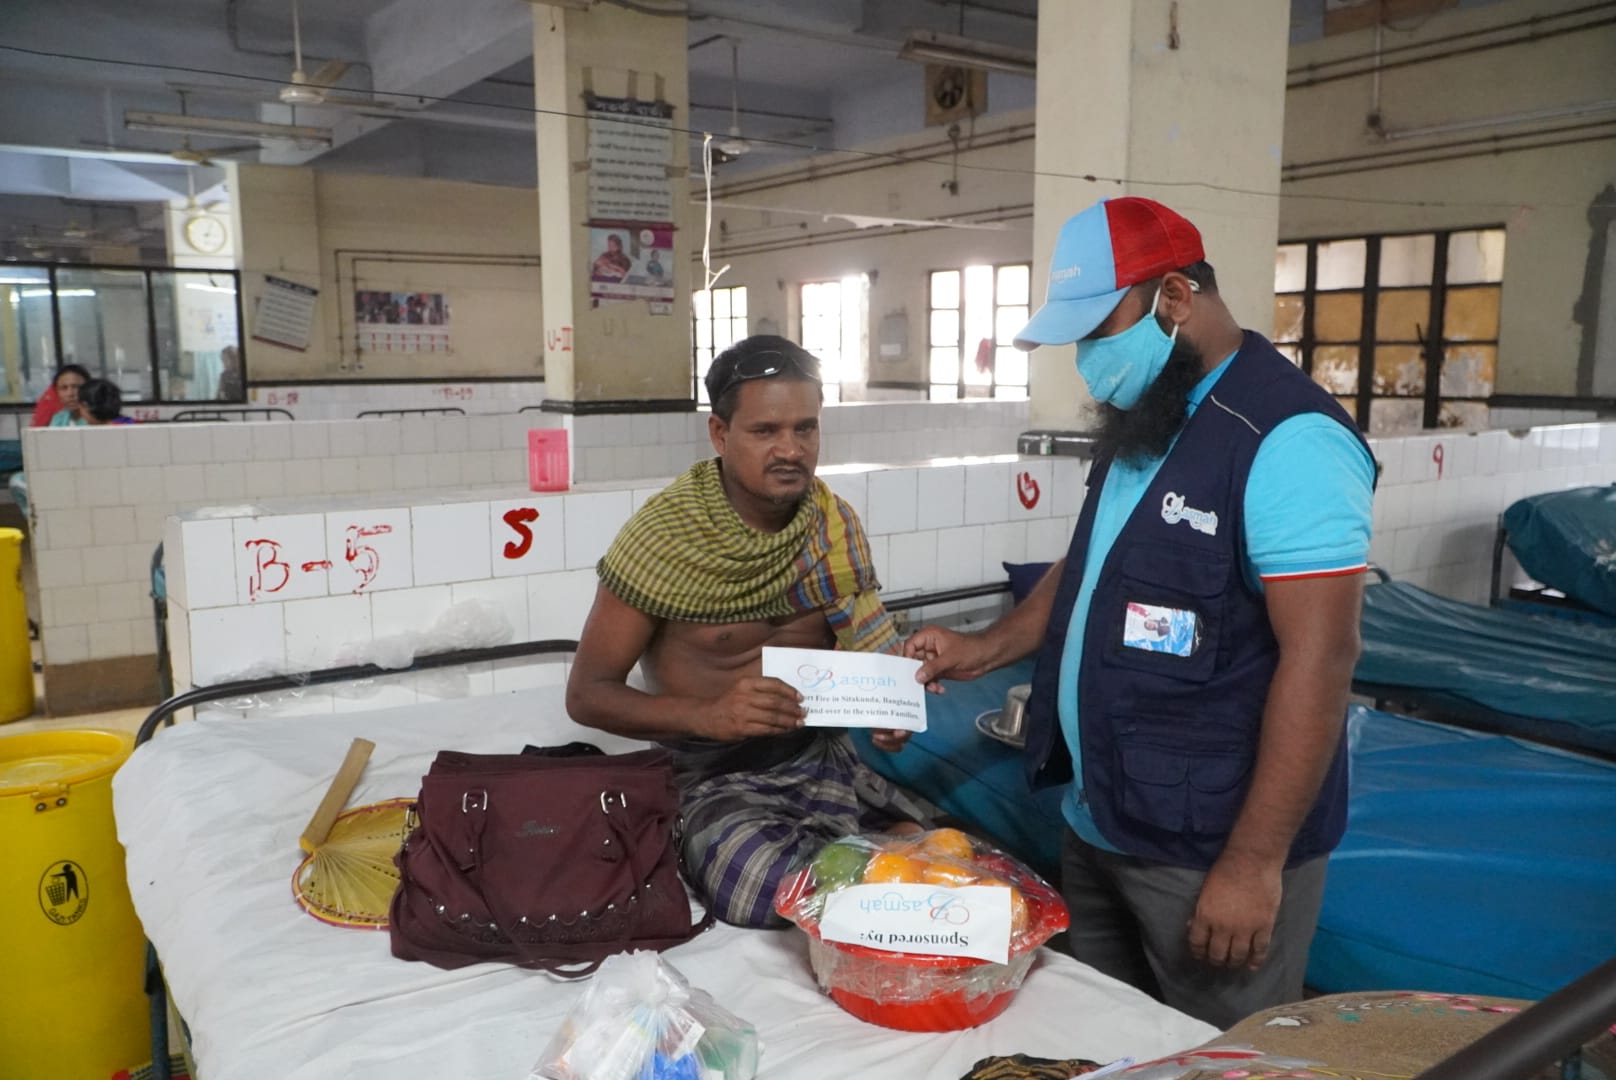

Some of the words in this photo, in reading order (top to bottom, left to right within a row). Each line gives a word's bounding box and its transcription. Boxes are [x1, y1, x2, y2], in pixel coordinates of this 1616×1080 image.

[796, 663, 897, 692] Basmah
[882, 696, 921, 708] Bangladesh
[852, 707, 864, 715] the
[865, 708, 889, 716] victim
[859, 890, 971, 927] Basmah
[859, 929, 885, 946] by:
[889, 930, 970, 948] Sponsored
